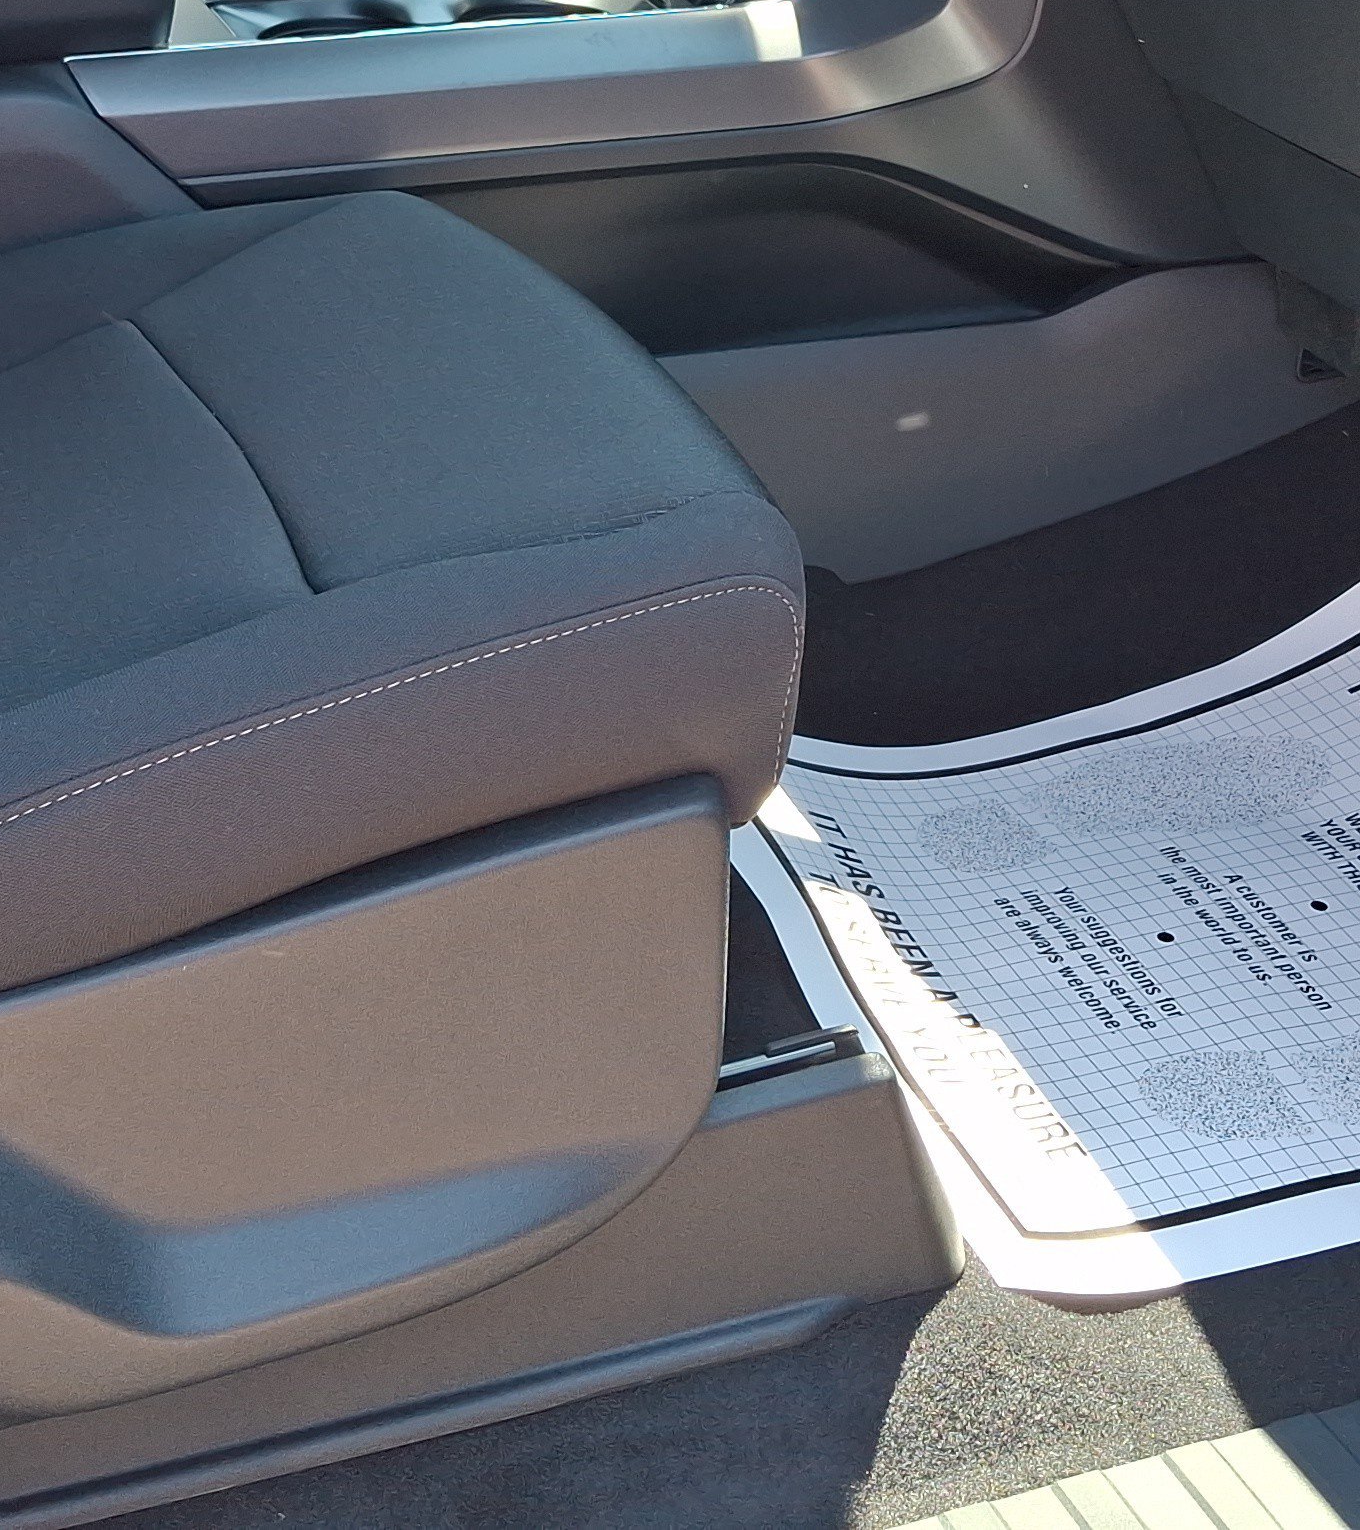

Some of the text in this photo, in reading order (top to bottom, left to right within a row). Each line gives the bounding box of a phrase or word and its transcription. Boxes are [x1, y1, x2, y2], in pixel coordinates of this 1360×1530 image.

[809, 811, 847, 839] IT
[828, 842, 885, 904] HAS
[870, 906, 943, 978] BEEN
[923, 989, 958, 1003] A
[1301, 831, 1344, 860] WITH
[994, 897, 1123, 1034] are always welcome.
[1021, 890, 1157, 1030] improving our service
[1053, 886, 1185, 1019] Your suggestions for
[1157, 872, 1272, 986] in the world to us.
[1160, 846, 1332, 1012] the most important person
[1224, 875, 1318, 963] A customer is
